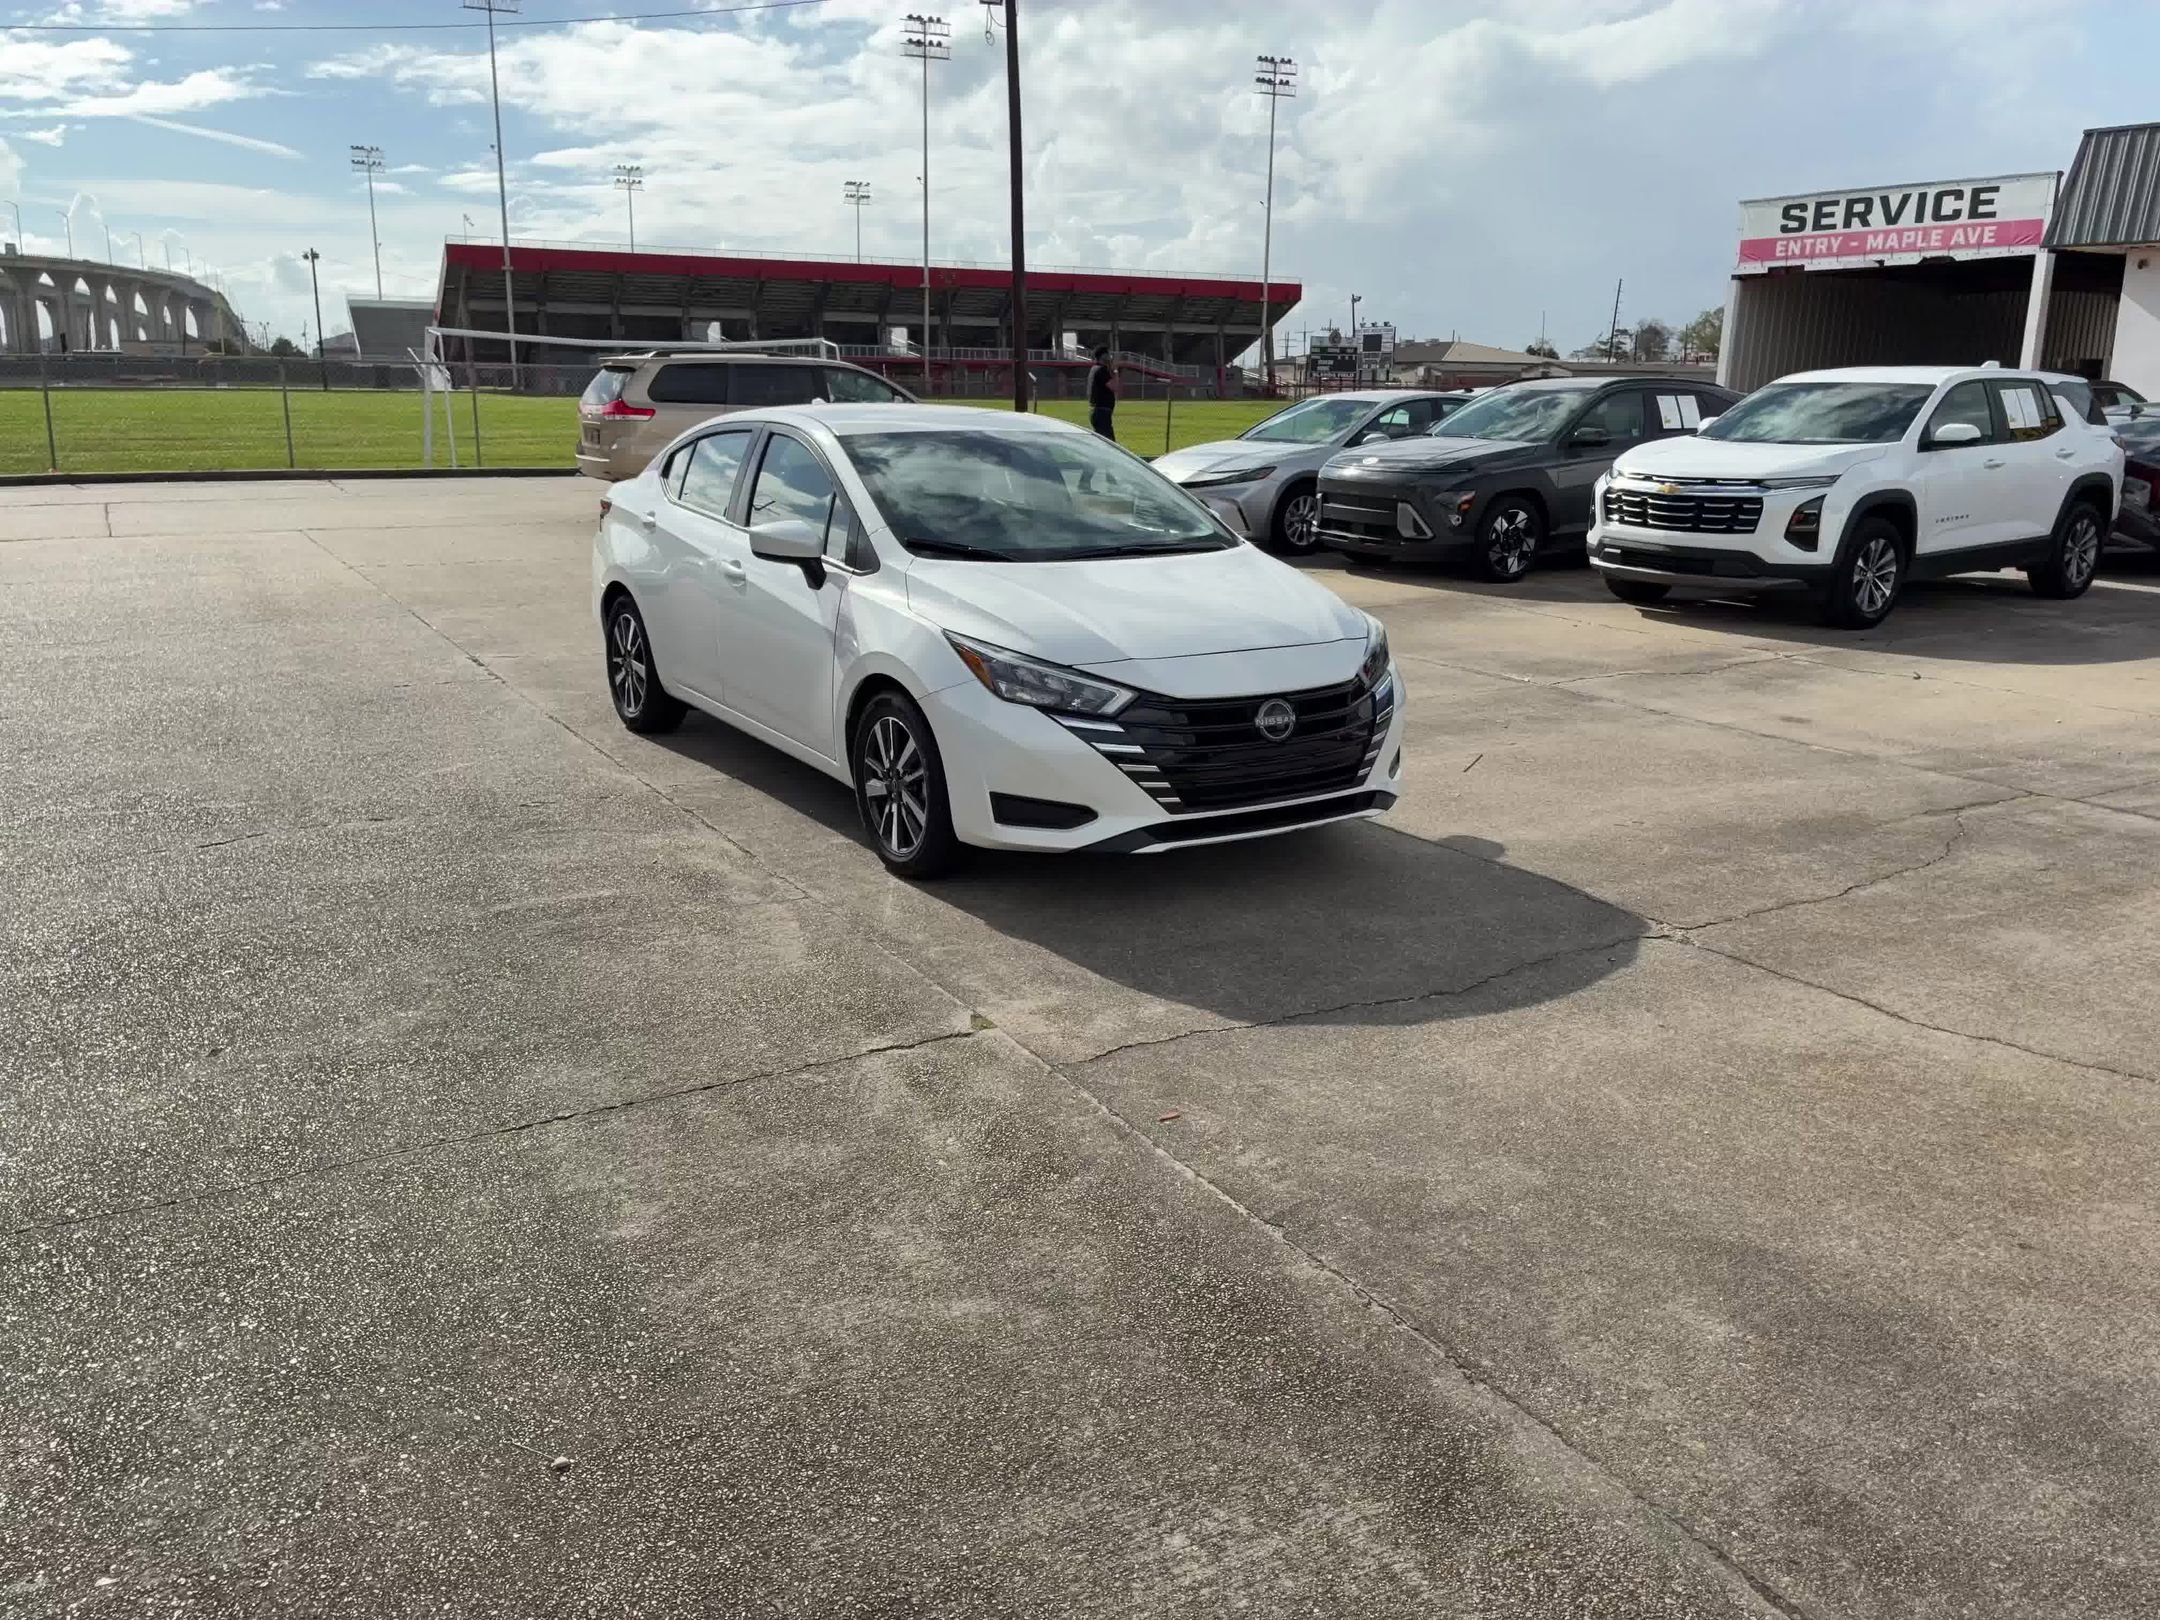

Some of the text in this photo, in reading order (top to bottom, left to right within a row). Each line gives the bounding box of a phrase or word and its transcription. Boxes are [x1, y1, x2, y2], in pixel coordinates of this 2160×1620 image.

[1780, 186, 2000, 234] SERVICE
[1775, 237, 1843, 257] ENTRY
[1865, 229, 1942, 251] MAPLE
[1950, 225, 1996, 246] AVE
[1255, 714, 1296, 727] NISSAN
